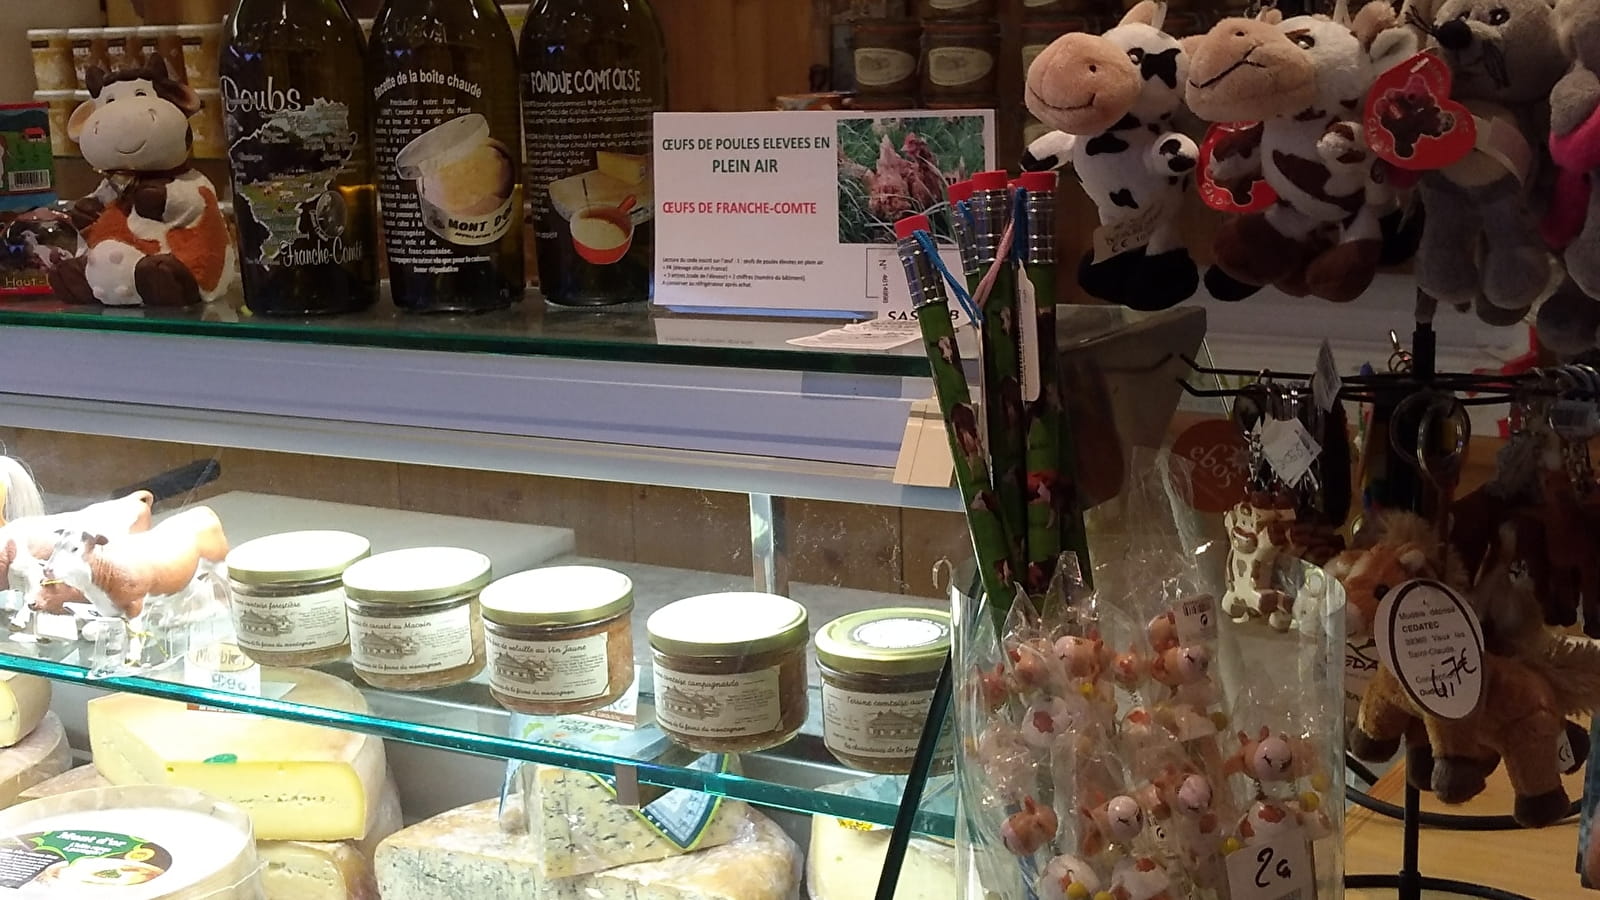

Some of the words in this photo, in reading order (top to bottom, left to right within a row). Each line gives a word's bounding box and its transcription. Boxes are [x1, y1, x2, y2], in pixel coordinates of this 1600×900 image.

[373, 76, 396, 101] Recette
[396, 71, 408, 86] de
[409, 69, 418, 83] la
[447, 74, 482, 98] chaude
[530, 70, 573, 95] FONDUE
[220, 75, 300, 112] Doubs
[662, 138, 695, 151] ŒUFS
[698, 138, 713, 151] DE
[715, 137, 760, 150] POULES
[763, 137, 811, 150] ELEVEES
[814, 136, 830, 149] EN
[712, 159, 750, 173] PLEIN
[754, 159, 779, 173] AIR
[662, 202, 696, 214] ŒUFS
[698, 202, 713, 214] DE
[716, 202, 817, 215] FRANCHE-COMTE
[448, 218, 488, 231] MONT
[1402, 621, 1440, 633] CEDATEC
[547, 646, 562, 654] Vin
[56, 831, 97, 843] Mont
